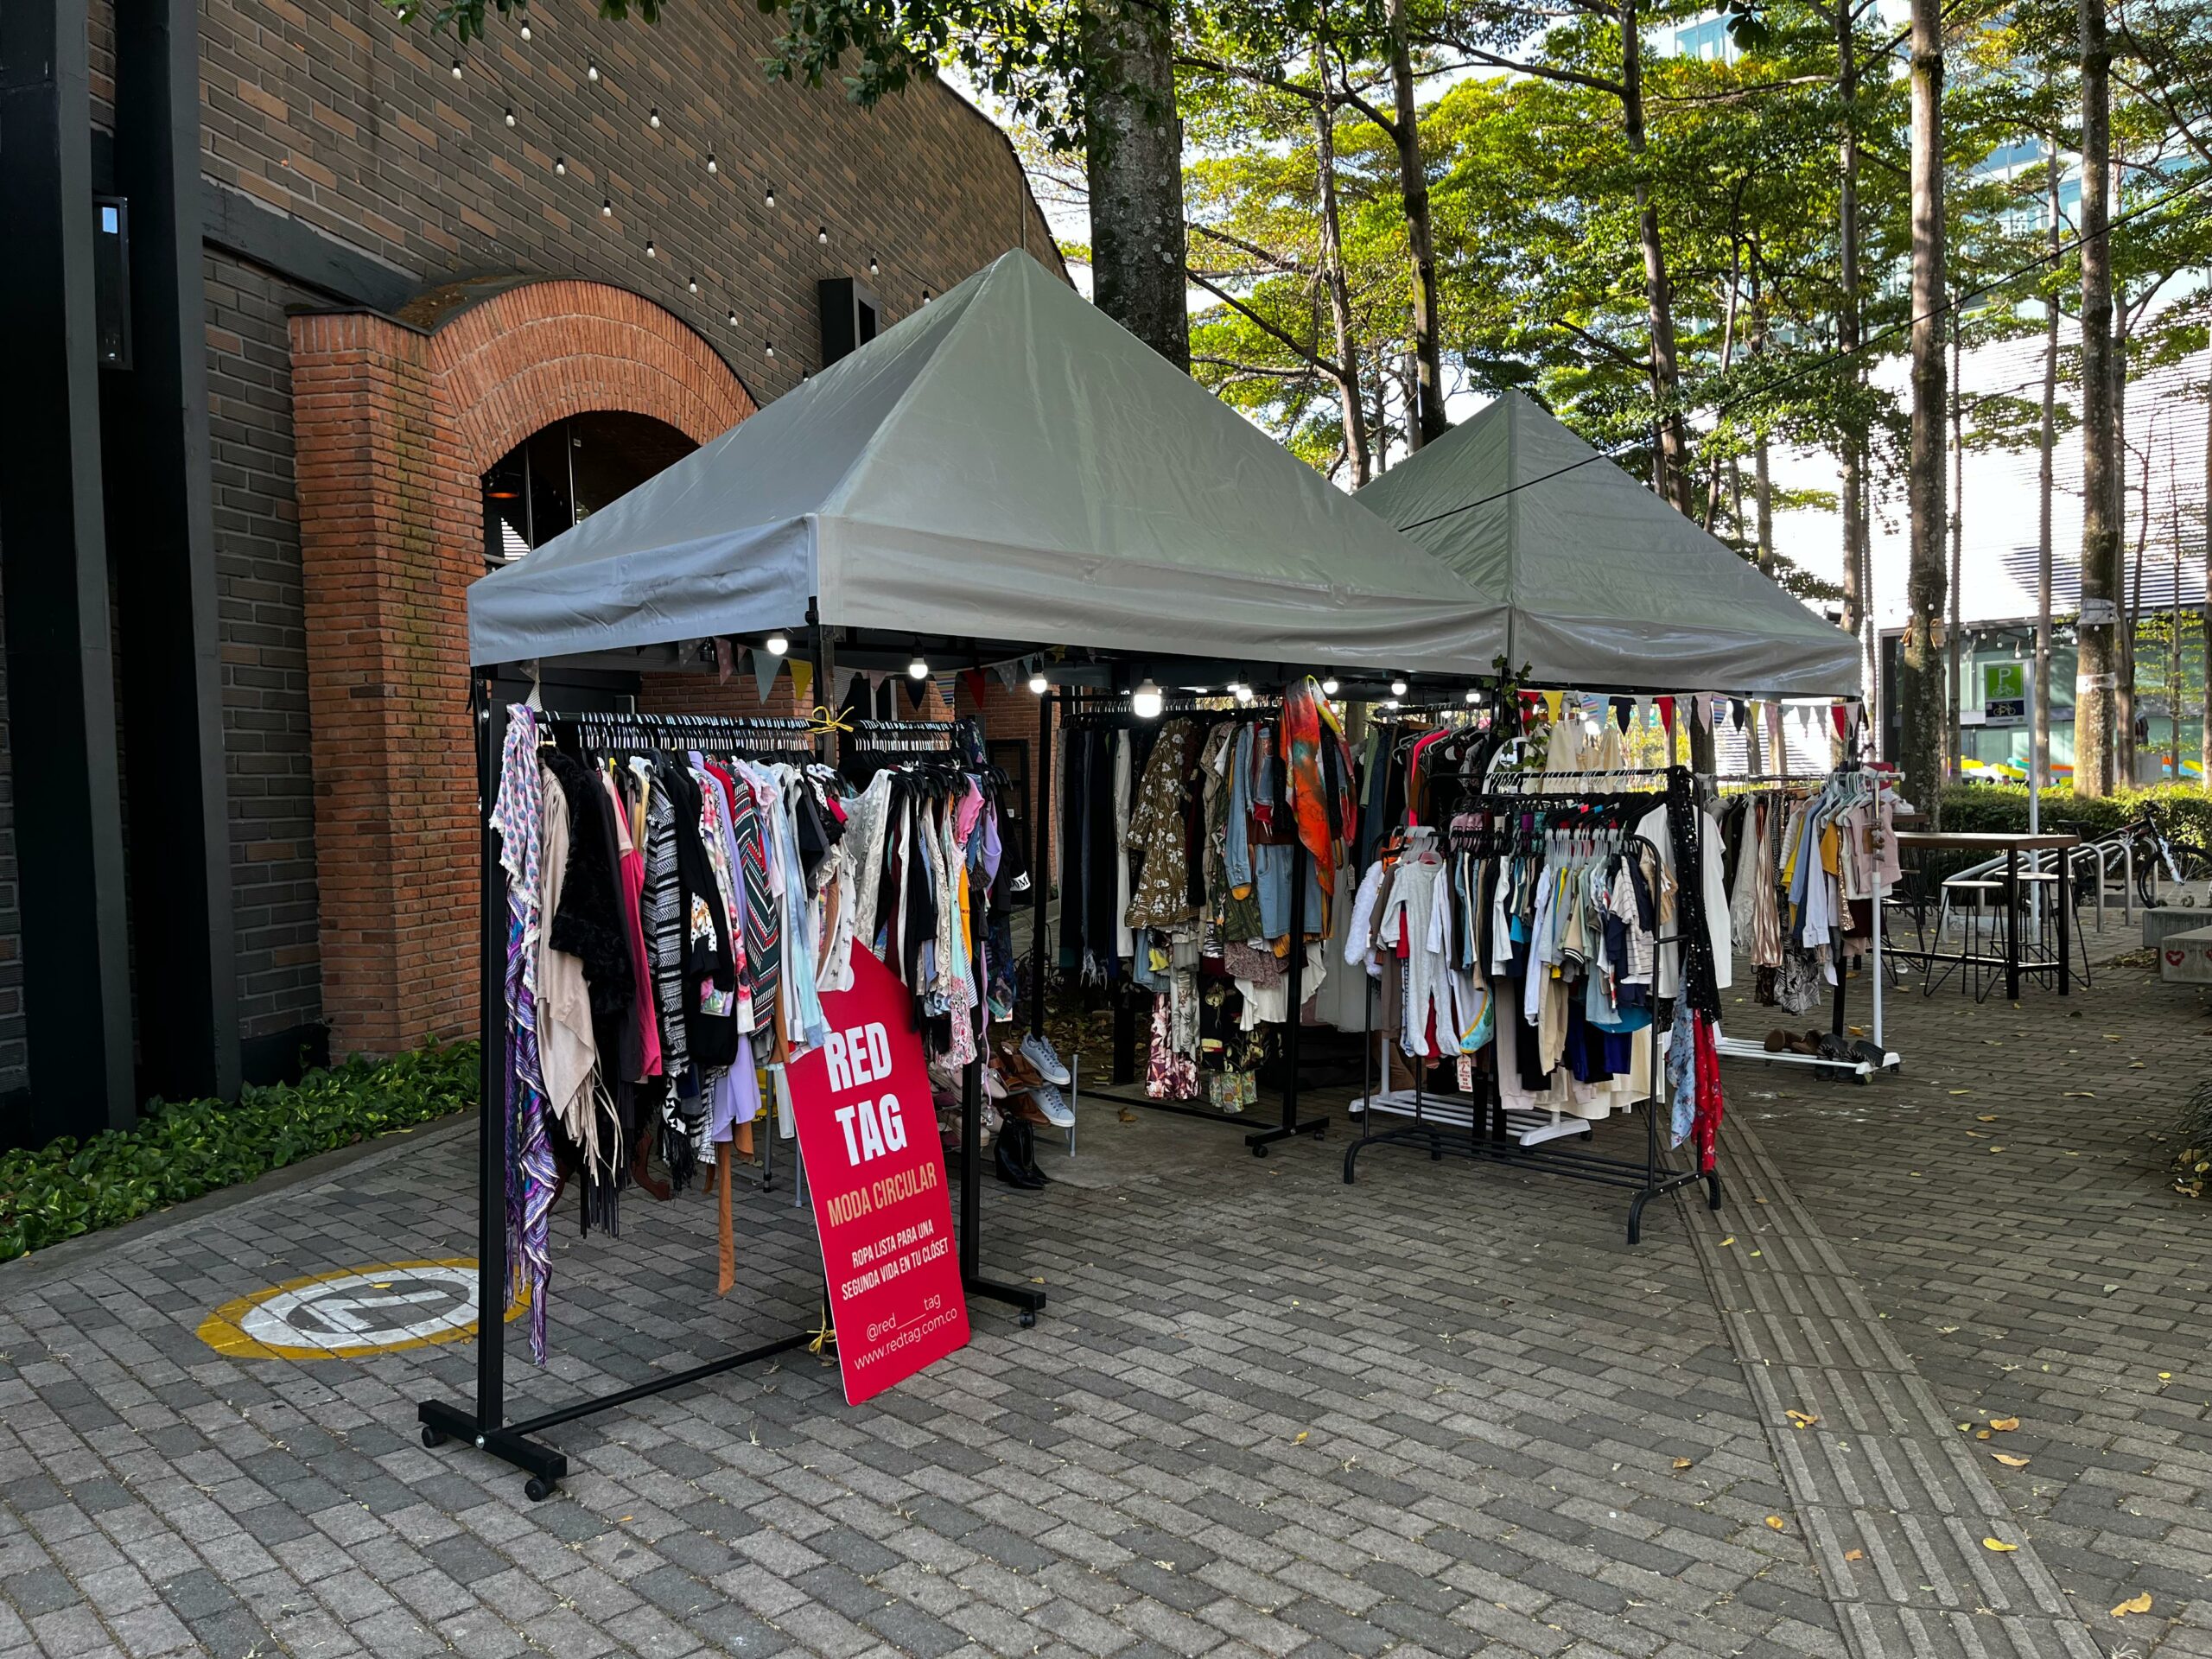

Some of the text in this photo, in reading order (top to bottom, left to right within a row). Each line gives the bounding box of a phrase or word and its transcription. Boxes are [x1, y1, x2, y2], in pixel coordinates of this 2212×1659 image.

[1998, 667, 2012, 685] P
[823, 1021, 893, 1093] RED
[835, 1093, 908, 1166] TAG
[827, 1161, 938, 1228] MODA CIRCULAR
[842, 1236, 949, 1301] SEGUNDA VIDA EN TU CLÓSET
[851, 1218, 934, 1269] ROPA LISTA PARA UNA
[854, 1307, 957, 1370] www.redtag.com.co
